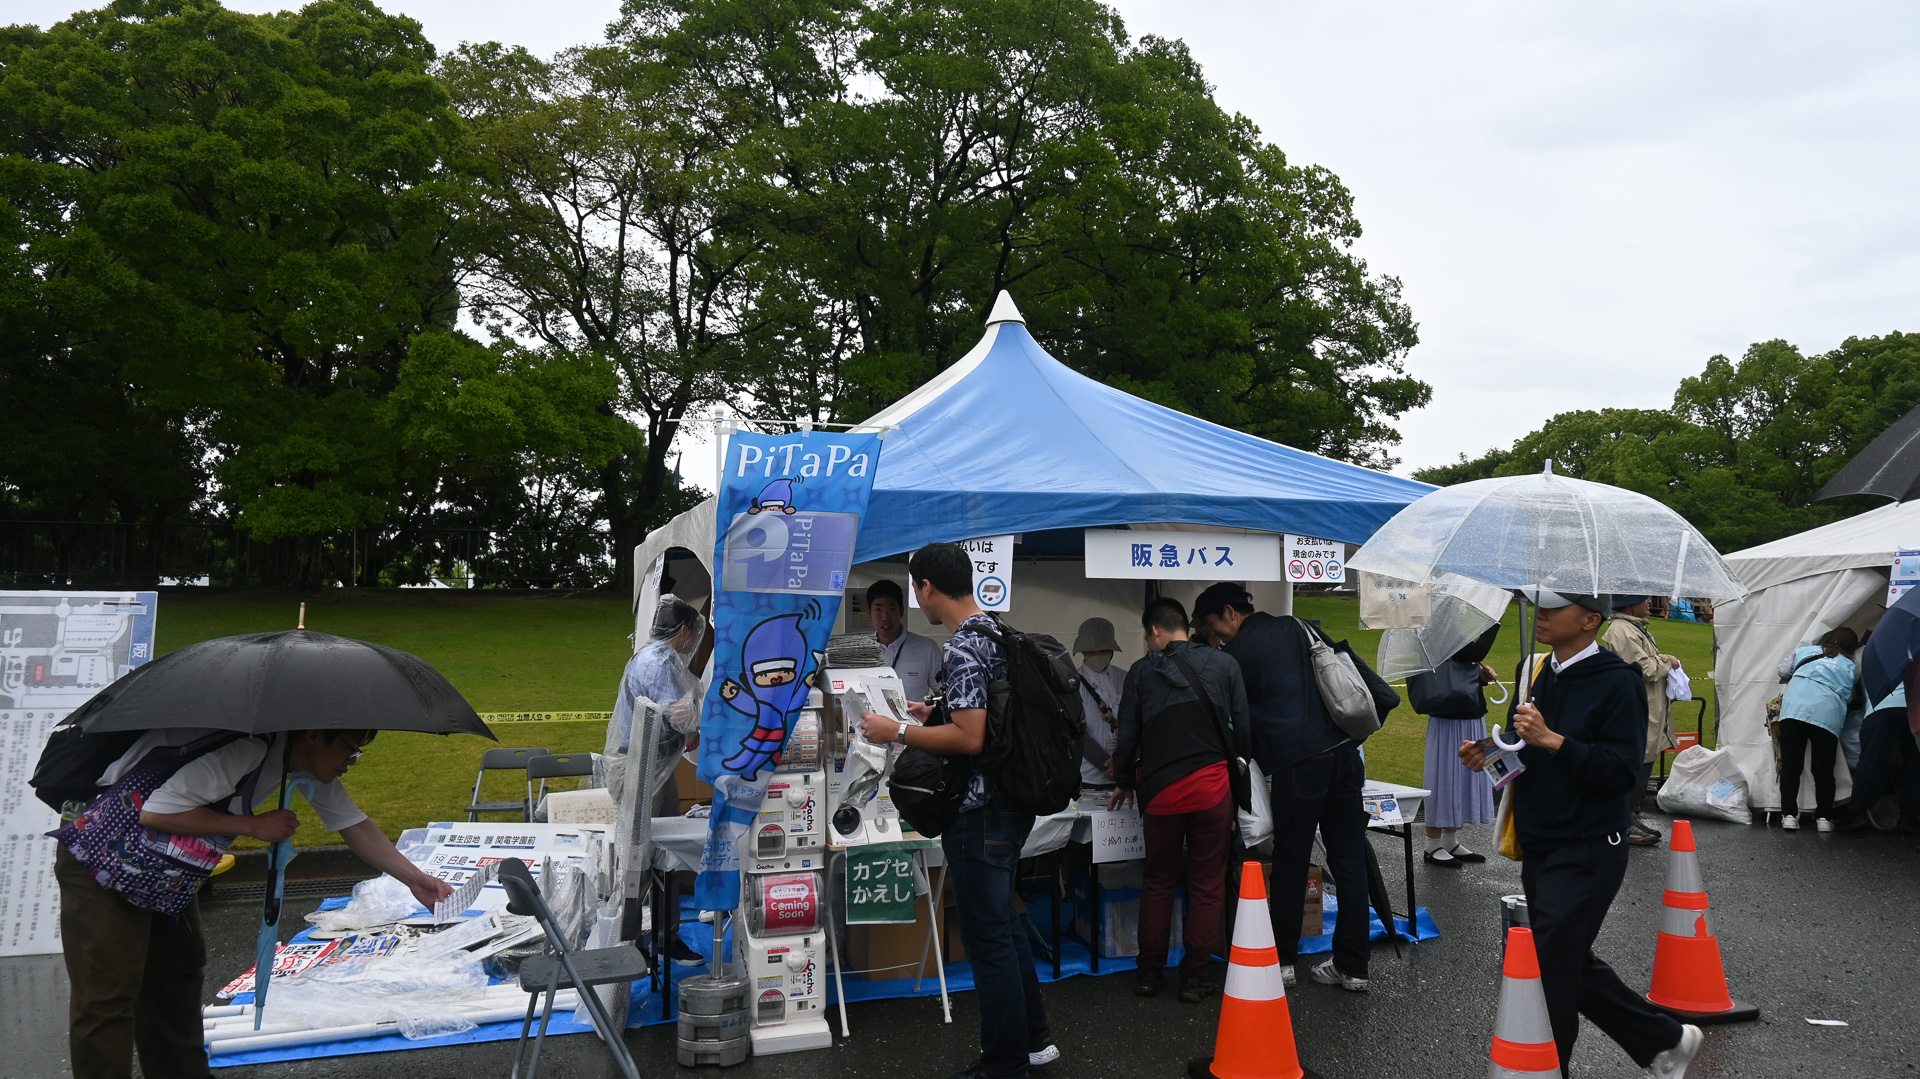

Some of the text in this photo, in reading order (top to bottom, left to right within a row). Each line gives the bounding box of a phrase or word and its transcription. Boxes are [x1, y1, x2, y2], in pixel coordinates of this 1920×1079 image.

[737, 443, 869, 478] PiTaPa
[788, 517, 814, 589] PiTaPa
[1131, 543, 1234, 568] 阪急バス
[1292, 549, 1337, 559] 現金のみです
[806, 799, 816, 832] Gacha
[433, 855, 445, 864] 19
[853, 858, 913, 882] カプセ
[770, 900, 810, 911] Coming
[852, 883, 913, 905] かえし
[778, 910, 804, 919] Soon
[807, 962, 816, 995] Gacha
